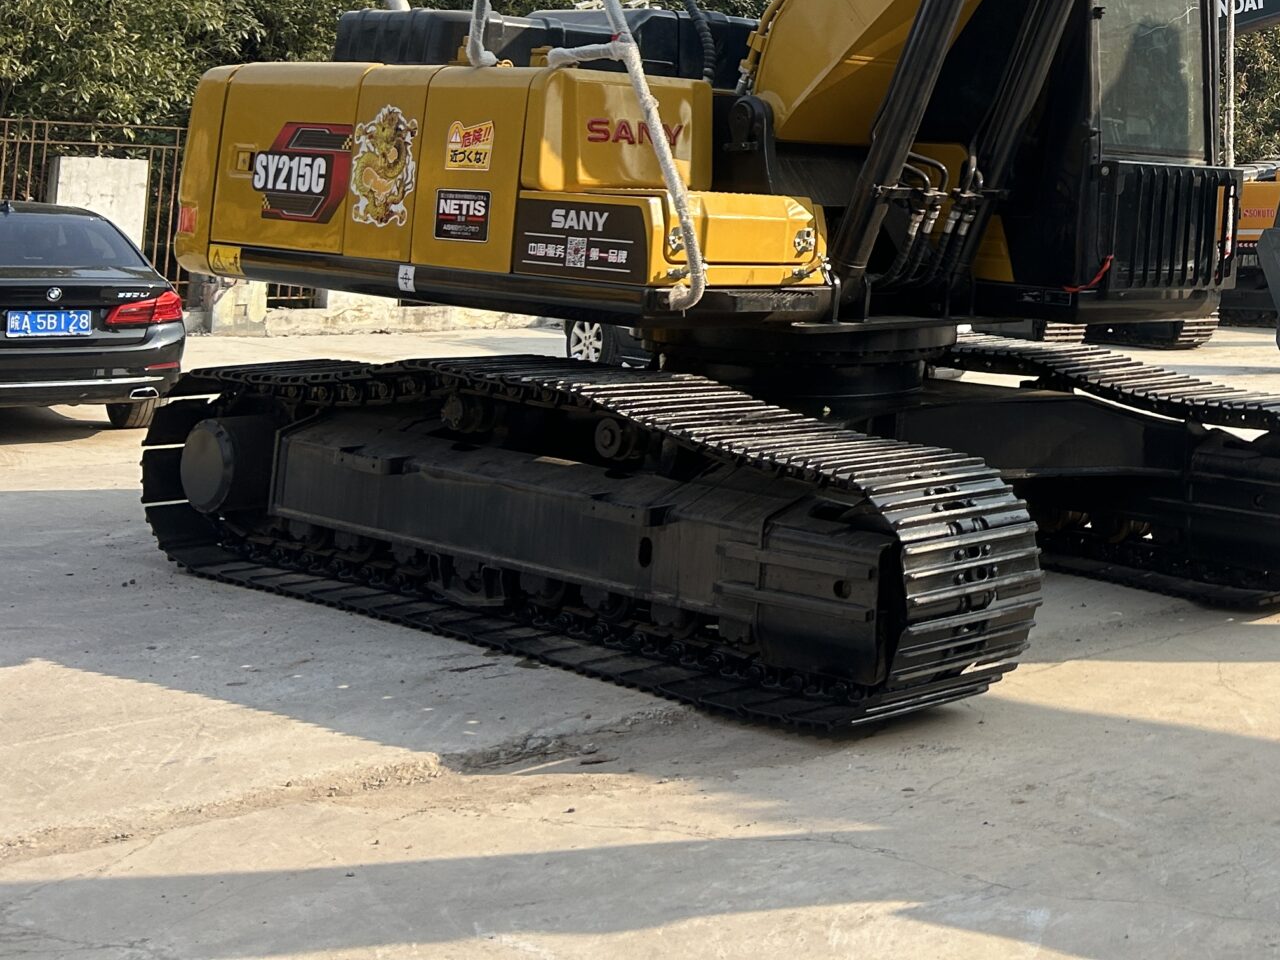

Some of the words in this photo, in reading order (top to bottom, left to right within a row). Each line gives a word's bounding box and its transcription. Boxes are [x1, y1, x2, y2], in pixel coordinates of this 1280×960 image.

[253, 153, 327, 193] SY215C
[439, 199, 486, 216] NETIS
[551, 208, 610, 232] SANY
